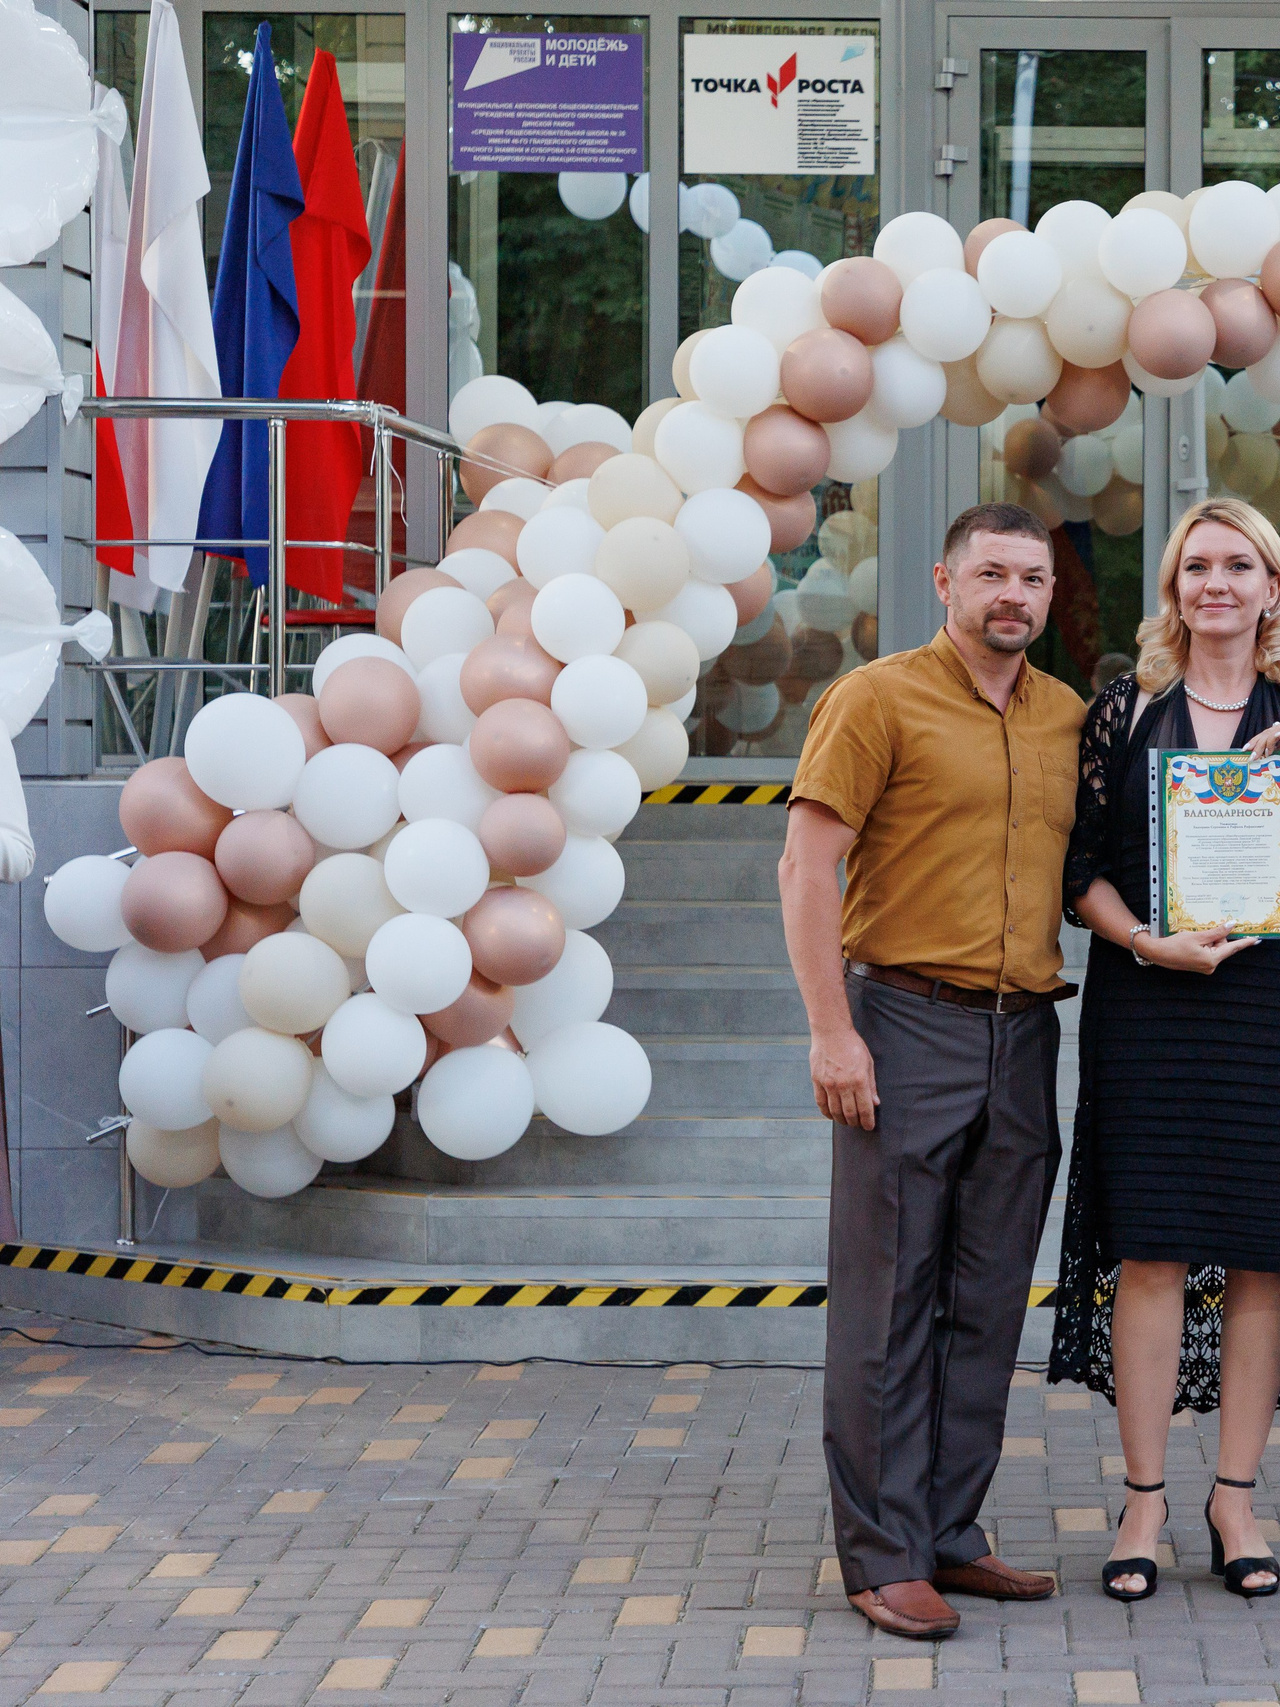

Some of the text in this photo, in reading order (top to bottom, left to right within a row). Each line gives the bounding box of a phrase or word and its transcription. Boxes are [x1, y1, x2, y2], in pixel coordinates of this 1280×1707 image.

[545, 37, 629, 53] МОЛОДЁЖЬ
[545, 54, 597, 68] И ДЕТИ
[691, 78, 865, 94] ТОЧКА РОСТА
[1183, 808, 1274, 818] БЛАГОДАРНОСТЬ
